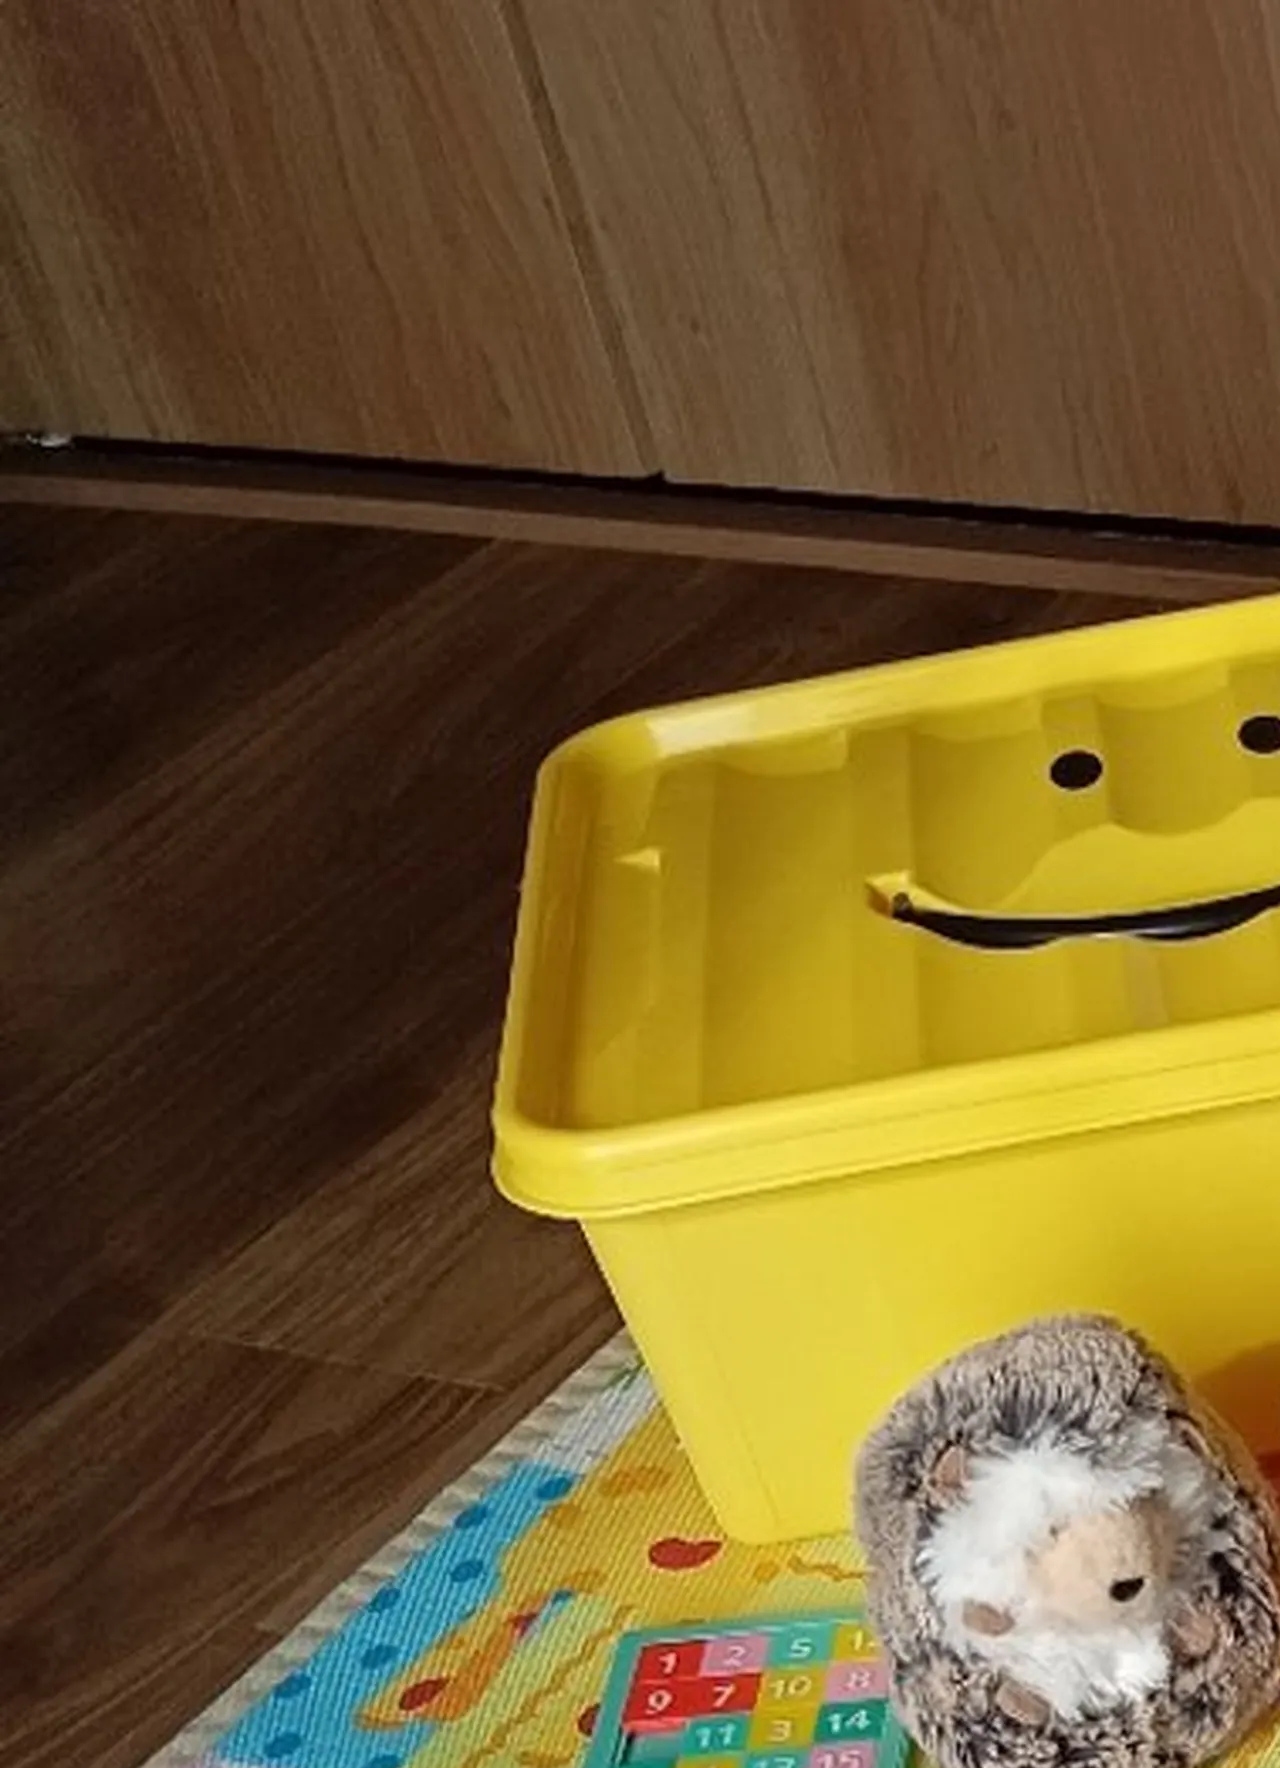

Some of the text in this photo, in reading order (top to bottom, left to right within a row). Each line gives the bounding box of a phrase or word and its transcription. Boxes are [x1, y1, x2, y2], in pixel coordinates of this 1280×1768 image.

[659, 1652, 677, 1674] 1
[722, 1646, 748, 1668] 2
[791, 1638, 811, 1658] 5
[647, 1689, 672, 1715] 9
[713, 1685, 737, 1708] 7
[771, 1675, 811, 1697] 10
[696, 1710, 871, 1747] 11 3 14
